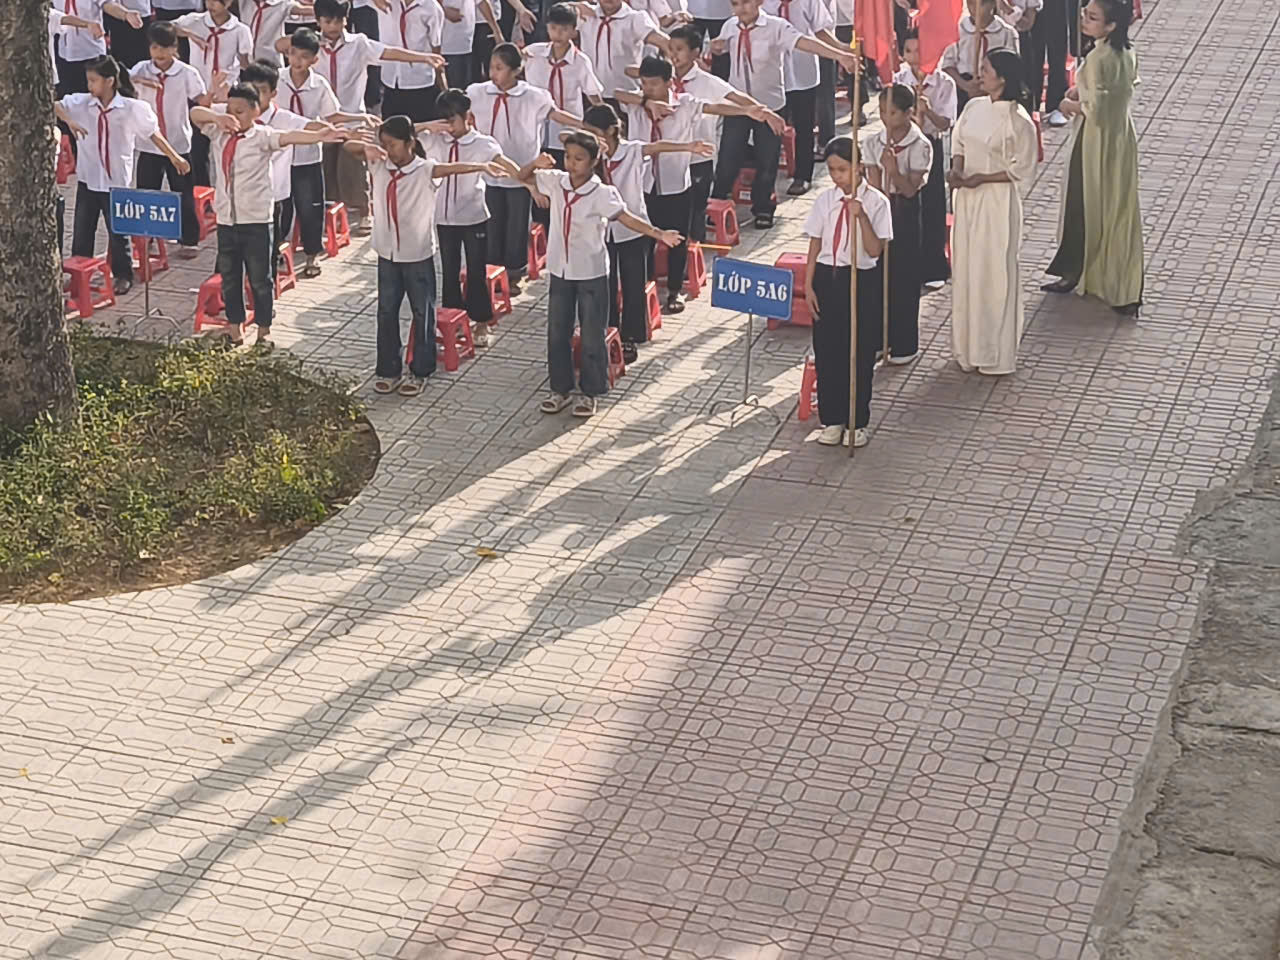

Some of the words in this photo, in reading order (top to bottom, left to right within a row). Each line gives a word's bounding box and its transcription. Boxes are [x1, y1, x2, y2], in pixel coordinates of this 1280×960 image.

[115, 199, 145, 219] LỚP
[149, 205, 177, 222] 5A7
[718, 270, 752, 294] LỚP
[756, 280, 788, 302] 5A6
